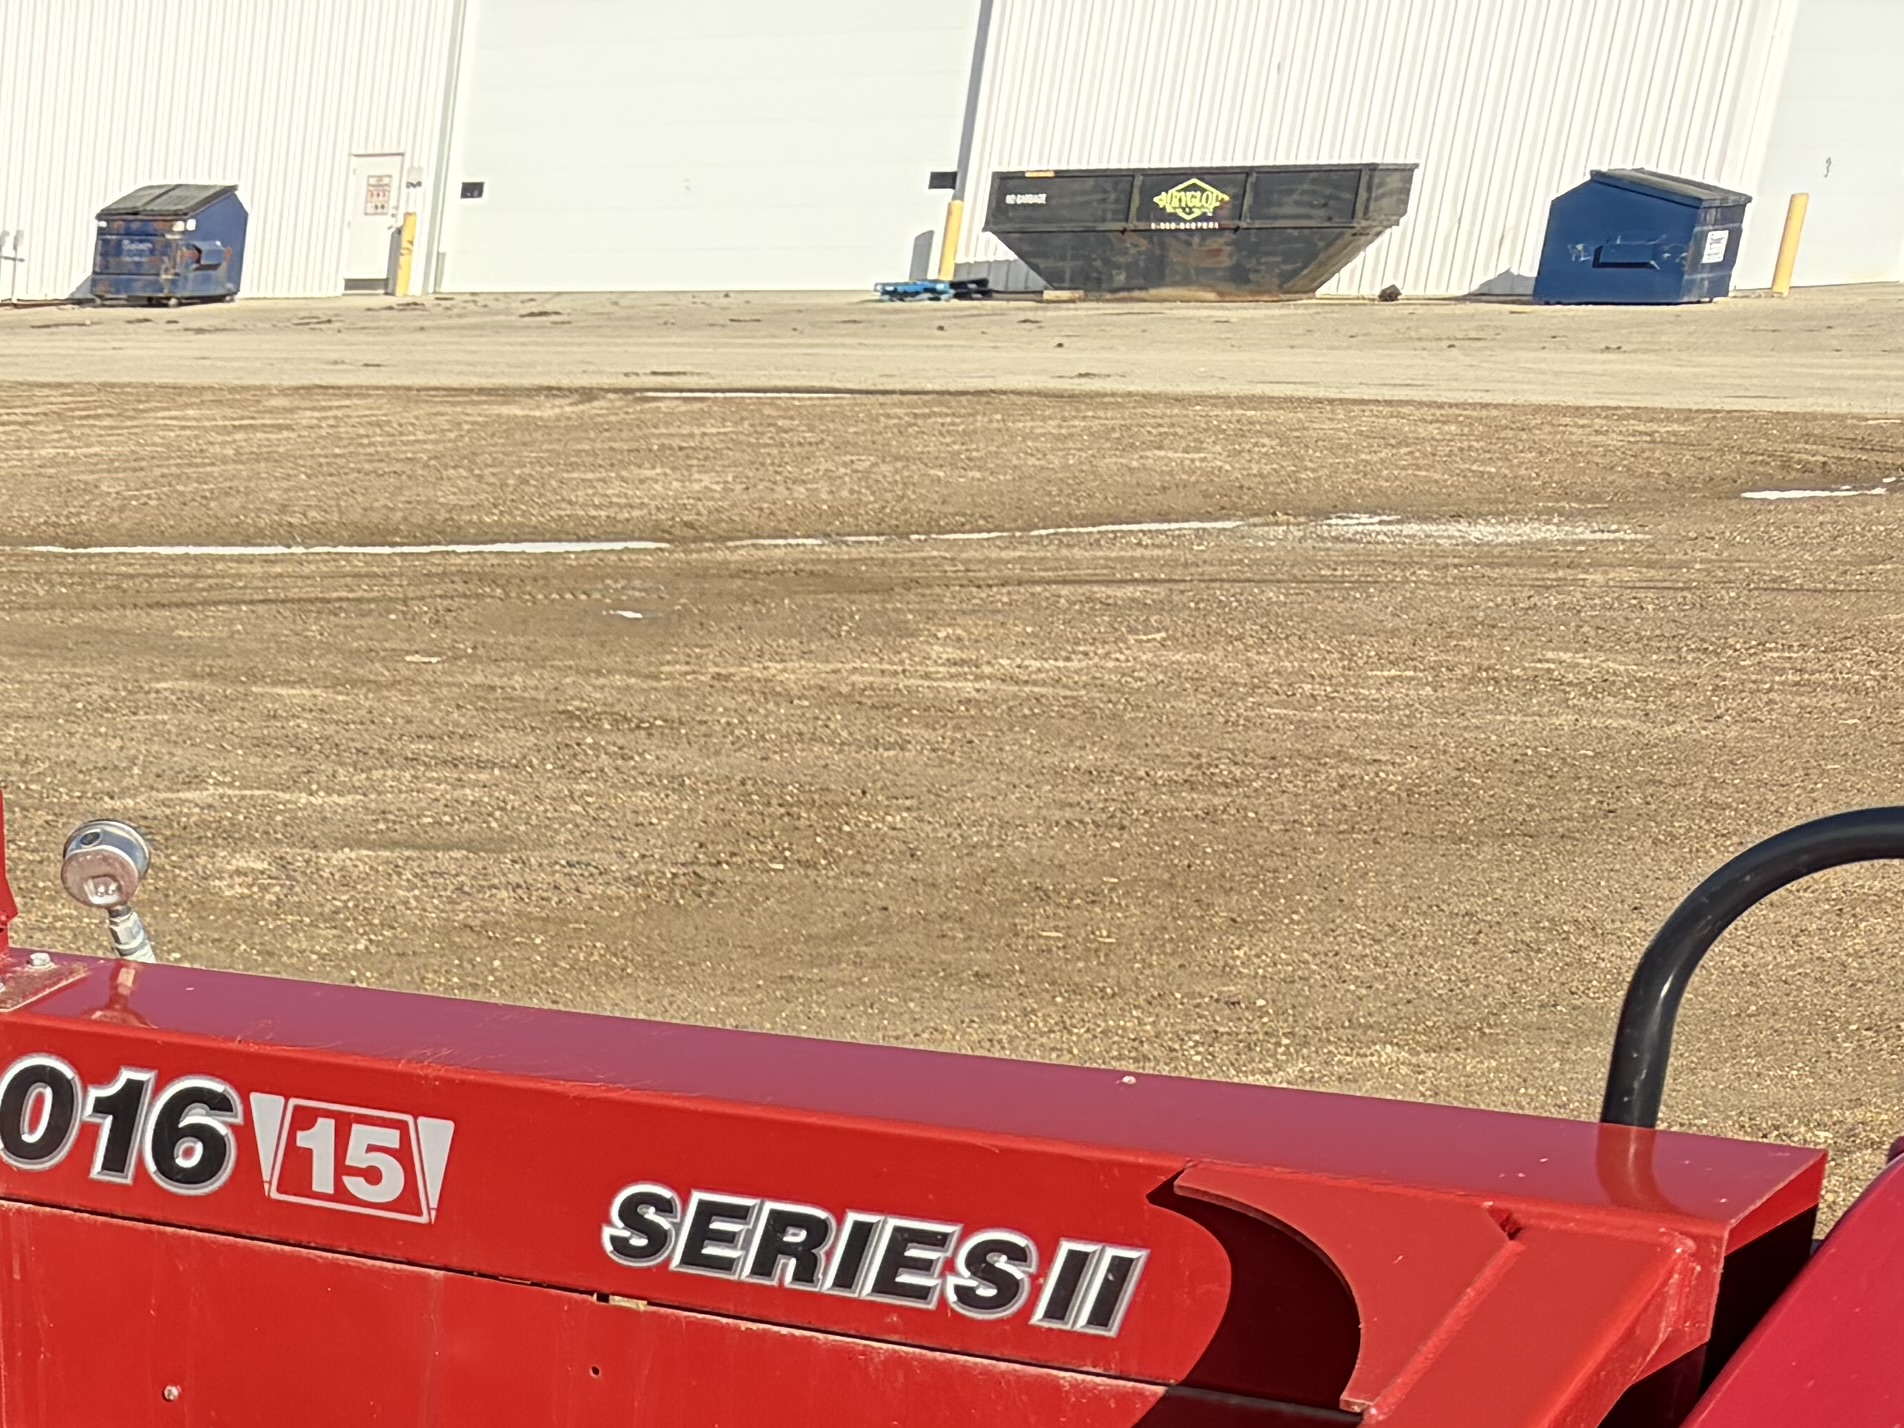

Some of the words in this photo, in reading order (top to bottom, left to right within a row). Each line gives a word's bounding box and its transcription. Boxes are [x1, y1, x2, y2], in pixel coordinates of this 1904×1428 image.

[293, 1115, 405, 1203] 15
[601, 1180, 1037, 1317] SERIES
[1028, 1241, 1152, 1337] II
